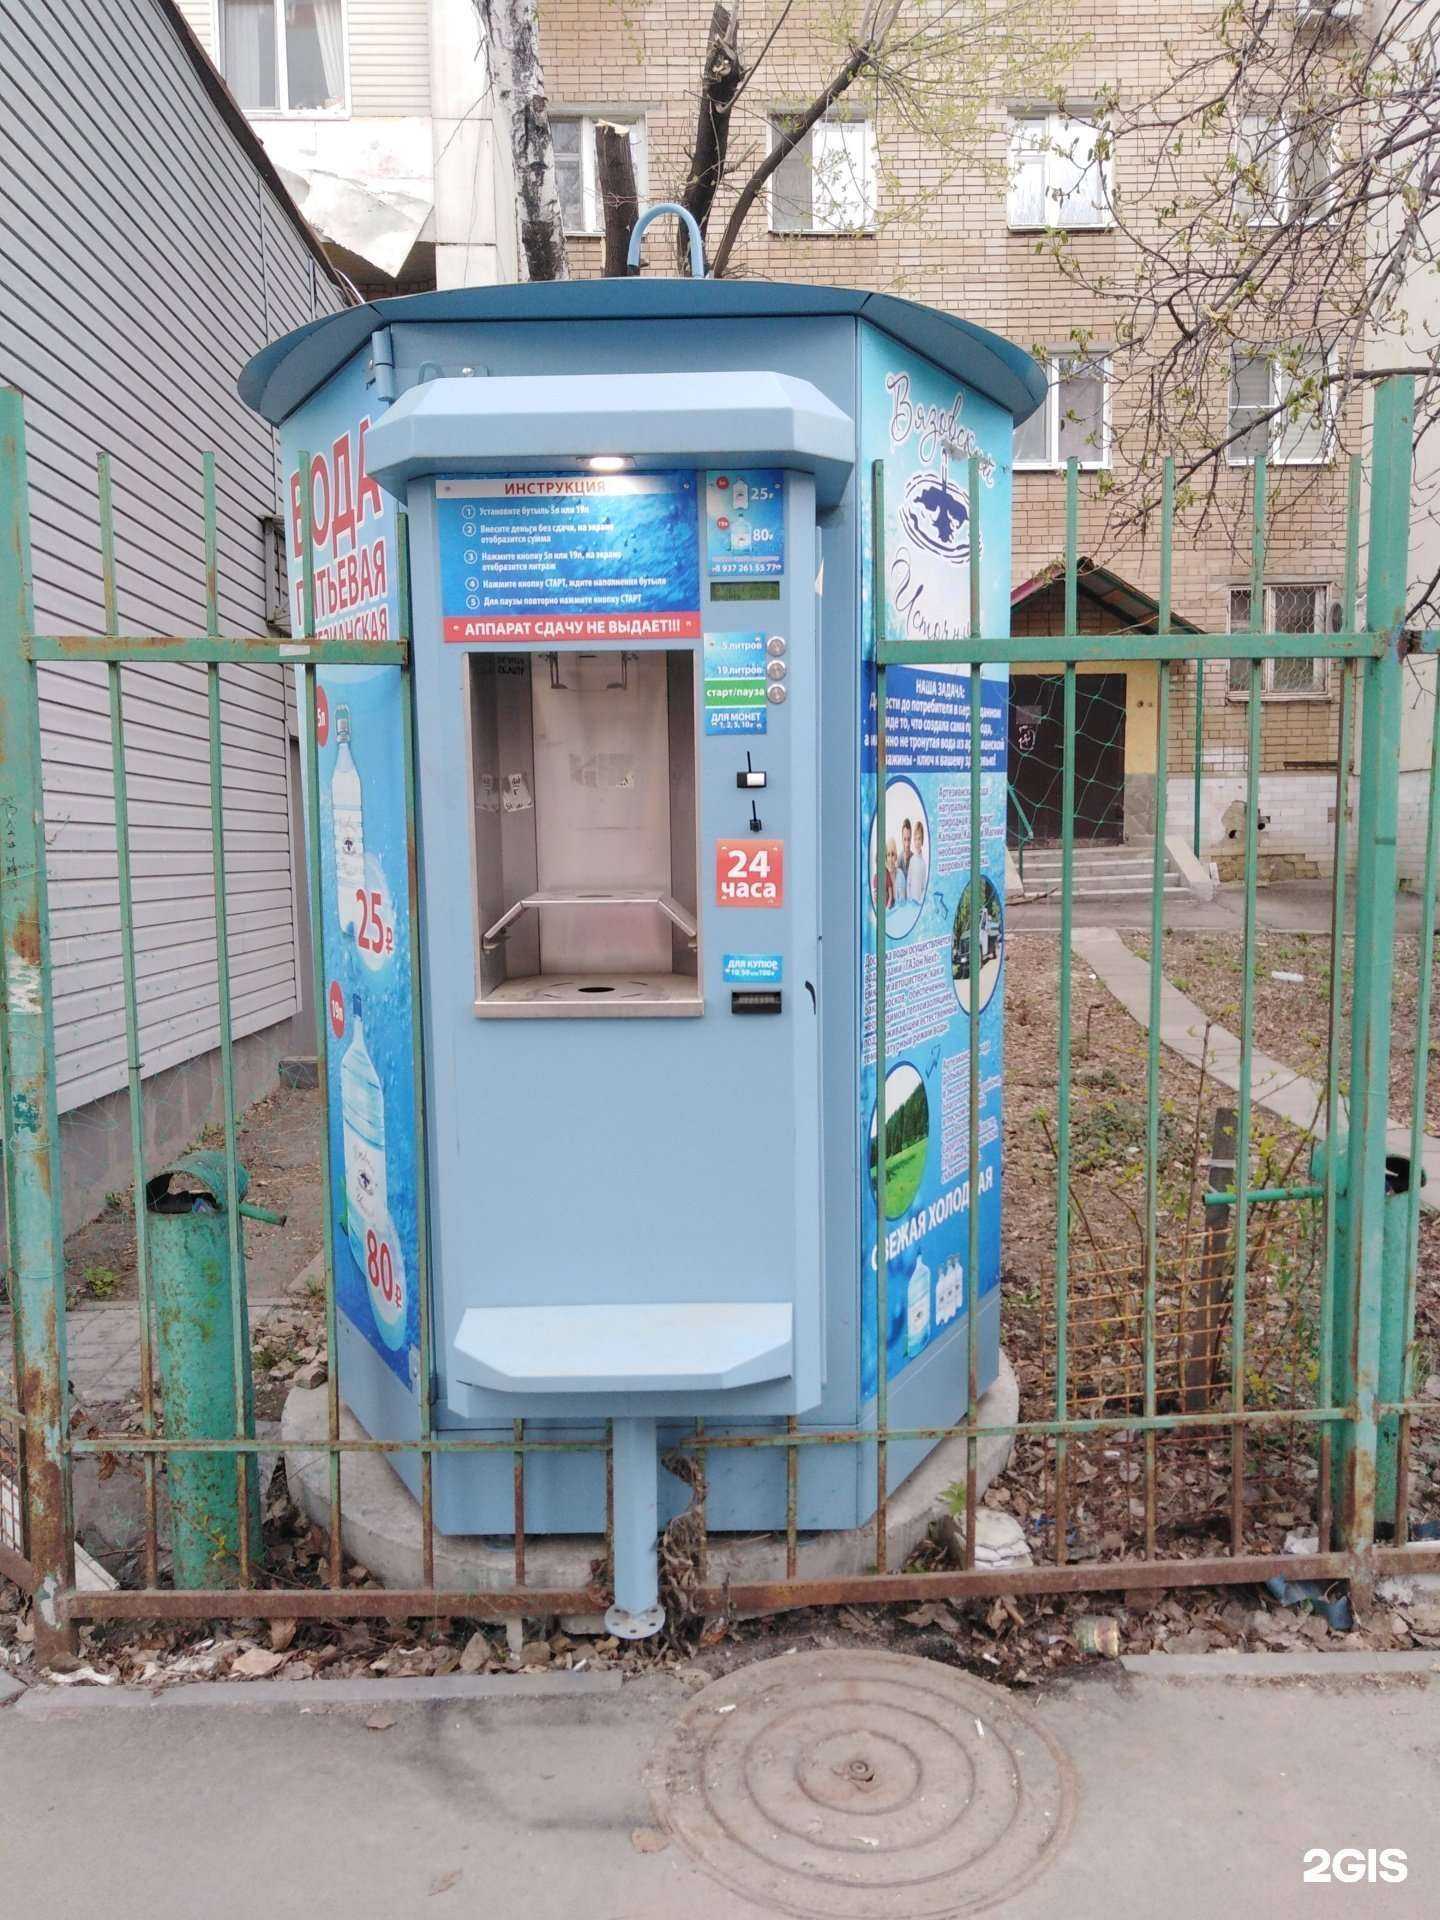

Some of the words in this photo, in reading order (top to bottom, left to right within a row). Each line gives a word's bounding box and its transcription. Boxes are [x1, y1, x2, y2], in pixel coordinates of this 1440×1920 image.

[504, 480, 606, 496] ИНСТРУКЦИЯ
[480, 507, 520, 517] Установите
[522, 505, 549, 517] бутыль
[561, 505, 574, 514] или
[480, 525, 510, 533] Внесите
[511, 525, 537, 536] деньги
[538, 523, 551, 533] без
[481, 535, 528, 545] отобразится
[482, 552, 516, 560] Нажмите
[517, 552, 543, 562] кнопку
[554, 551, 567, 559] или
[482, 563, 527, 573] отобразится
[483, 580, 516, 588] Нажмите
[518, 580, 544, 589] кнопку
[484, 597, 498, 607] Для
[499, 598, 522, 608] паузы
[524, 597, 558, 607] повторно
[559, 596, 592, 605] нажмите
[593, 596, 619, 605] кнопку
[620, 594, 642, 604] СТАРТ
[465, 622, 532, 636] АППАРАТ
[534, 621, 583, 637] СДАЧУ
[586, 621, 605, 634] НЕ
[608, 619, 680, 636] ВЫДАЕТ!!!
[729, 641, 762, 651] литров
[729, 666, 762, 676] литров
[706, 688, 765, 699] старт/пауза
[915, 679, 937, 697] НАША
[901, 699, 910, 713] до
[712, 712, 730, 722] ДЛЯ
[730, 712, 761, 721] МОНЕТ
[911, 718, 921, 730] что
[727, 850, 771, 878] 24
[721, 881, 777, 898] часа
[928, 1165, 993, 1231] ХОЛОДАЯ
